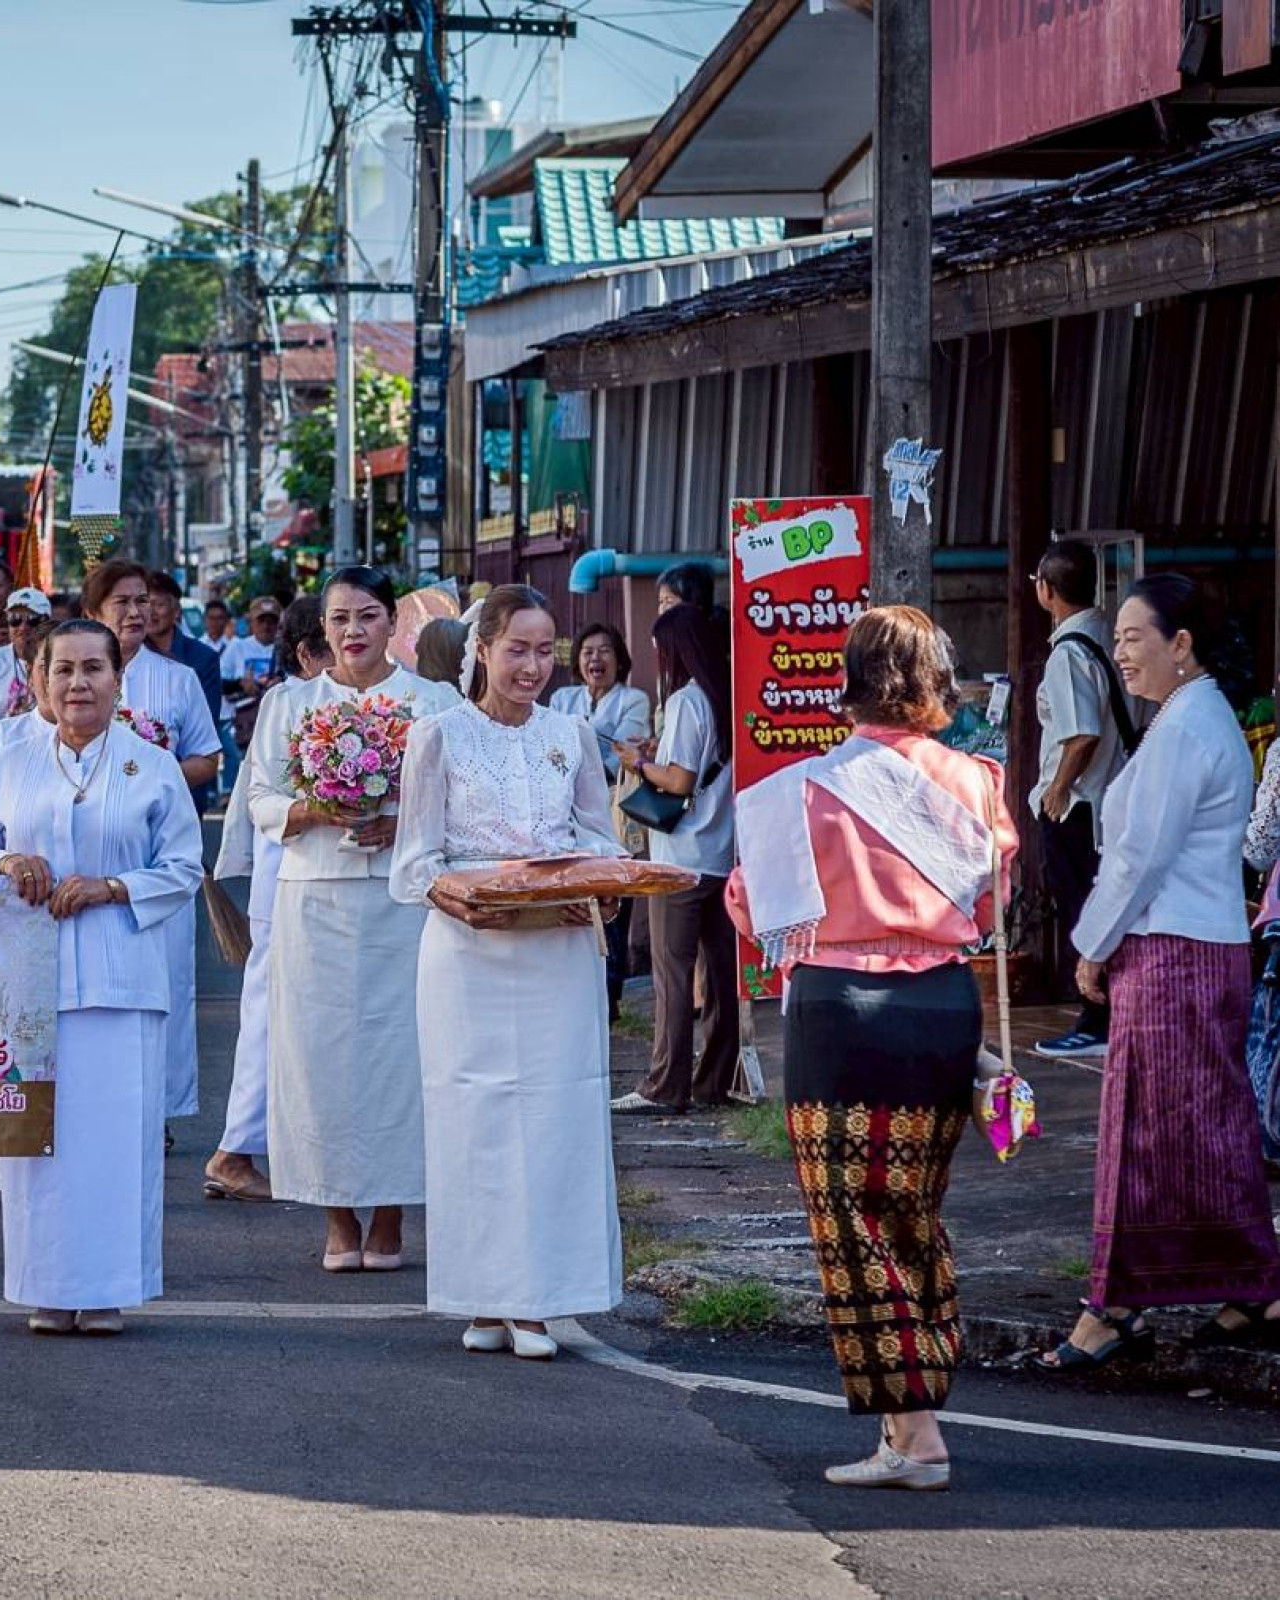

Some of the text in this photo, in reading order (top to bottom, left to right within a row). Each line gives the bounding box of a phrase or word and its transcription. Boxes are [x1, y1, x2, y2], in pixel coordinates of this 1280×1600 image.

[748, 520, 834, 560] ร้าน BP
[771, 645, 846, 671] ข้าวขา
[762, 681, 846, 714] ข้าวหมู
[754, 720, 853, 751] ข้าวหมูก
